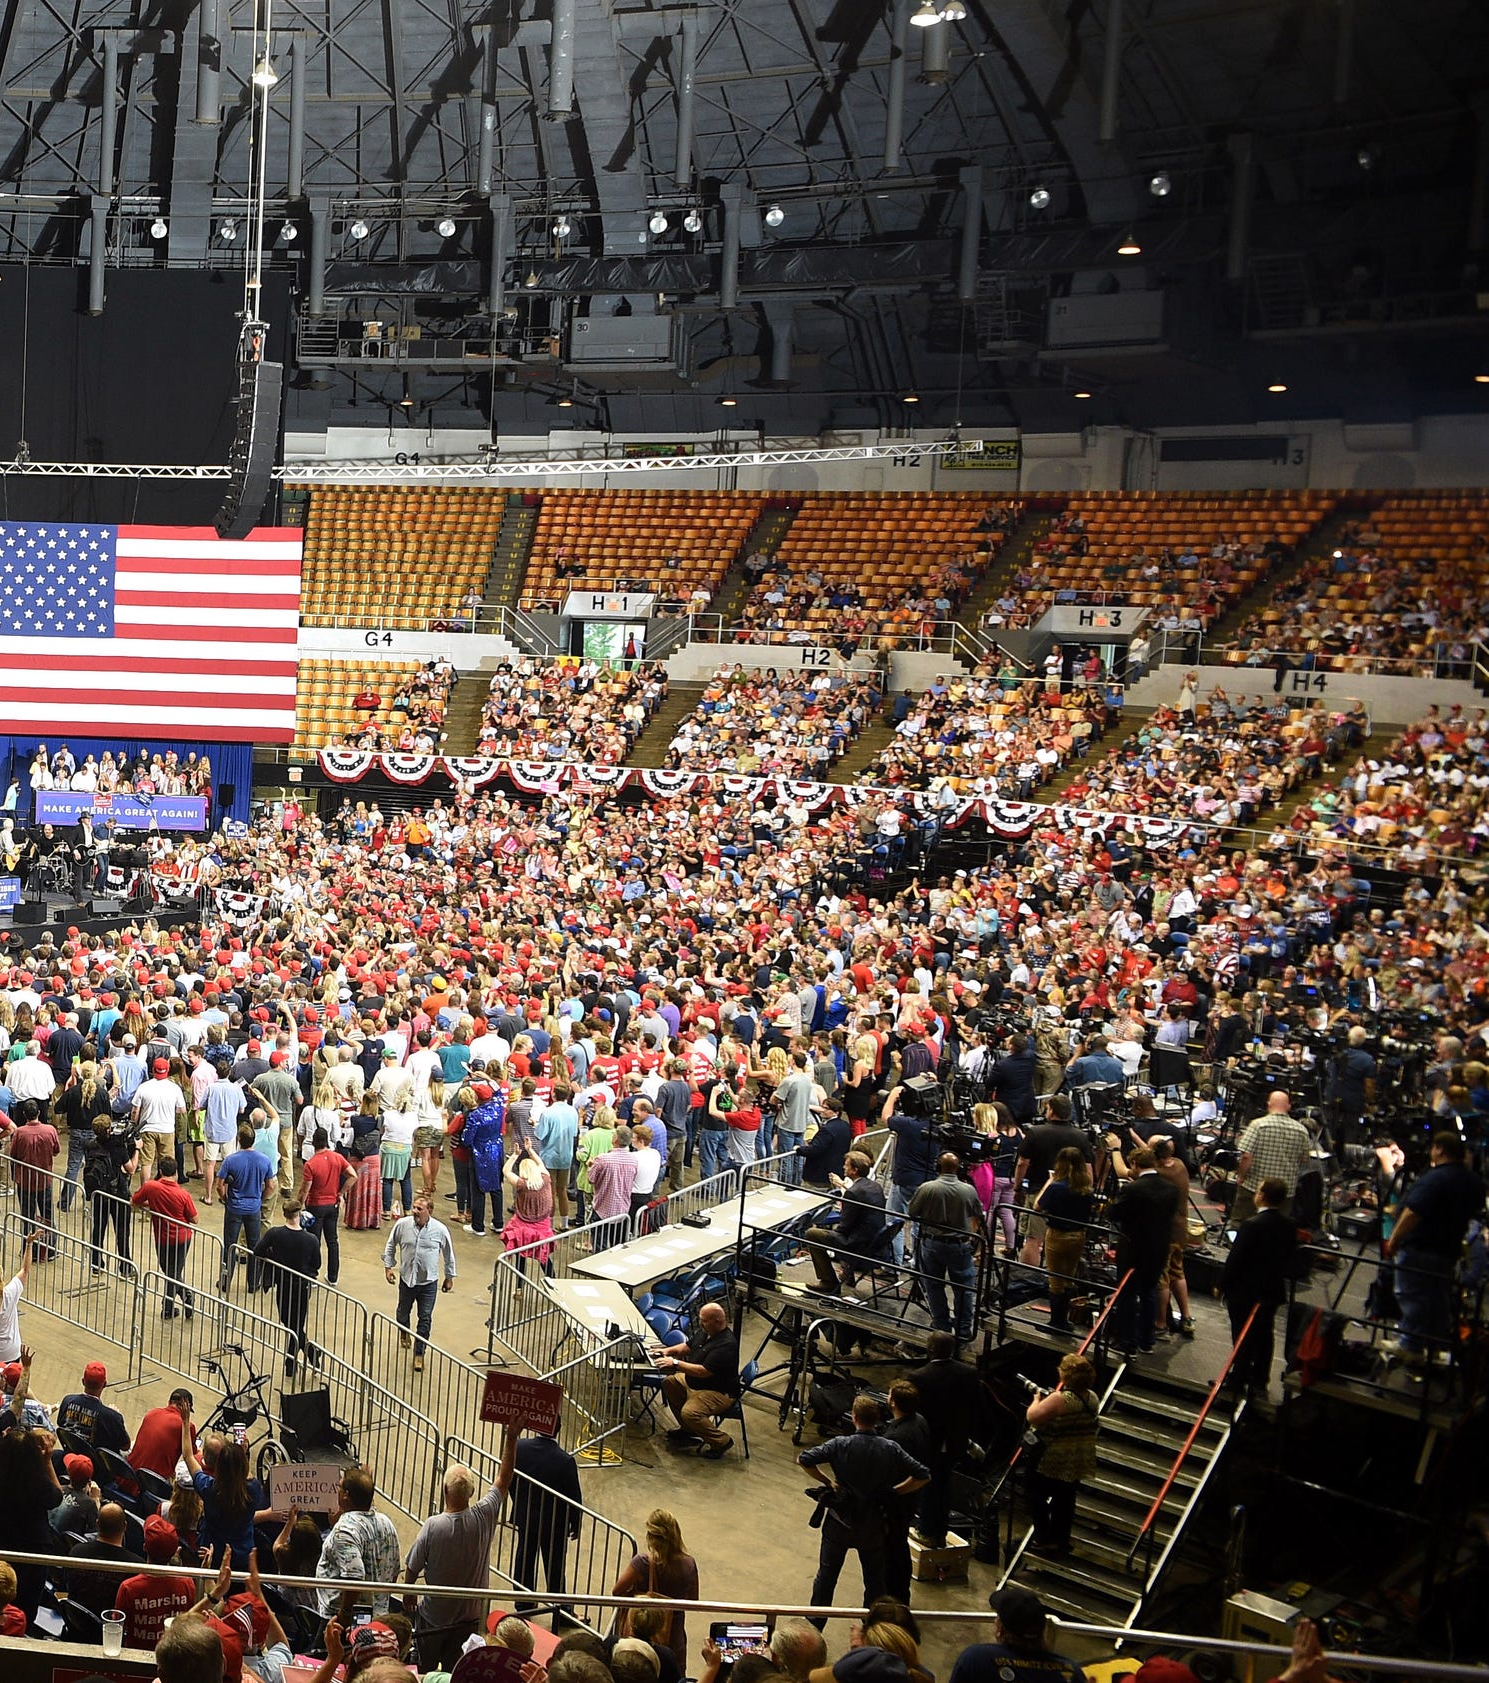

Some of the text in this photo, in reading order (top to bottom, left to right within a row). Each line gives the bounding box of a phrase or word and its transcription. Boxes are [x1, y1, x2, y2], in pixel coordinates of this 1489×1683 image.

[576, 323, 589, 332] 30
[395, 452, 421, 466] G4
[893, 455, 921, 468] H2
[365, 631, 393, 647] G4
[802, 648, 830, 665] H2
[1293, 672, 1328, 692] H4
[43, 804, 198, 819] MAKE AMERICA GREAT AGAIN!
[511, 1383, 537, 1395] MAKE
[486, 1389, 556, 1415] AMERICA
[485, 1403, 554, 1426] PROUD AGAIN
[292, 1470, 317, 1479] KEEP
[273, 1481, 337, 1494] AMERICA
[290, 1495, 320, 1505] GREAT
[134, 1593, 188, 1610] Marsha
